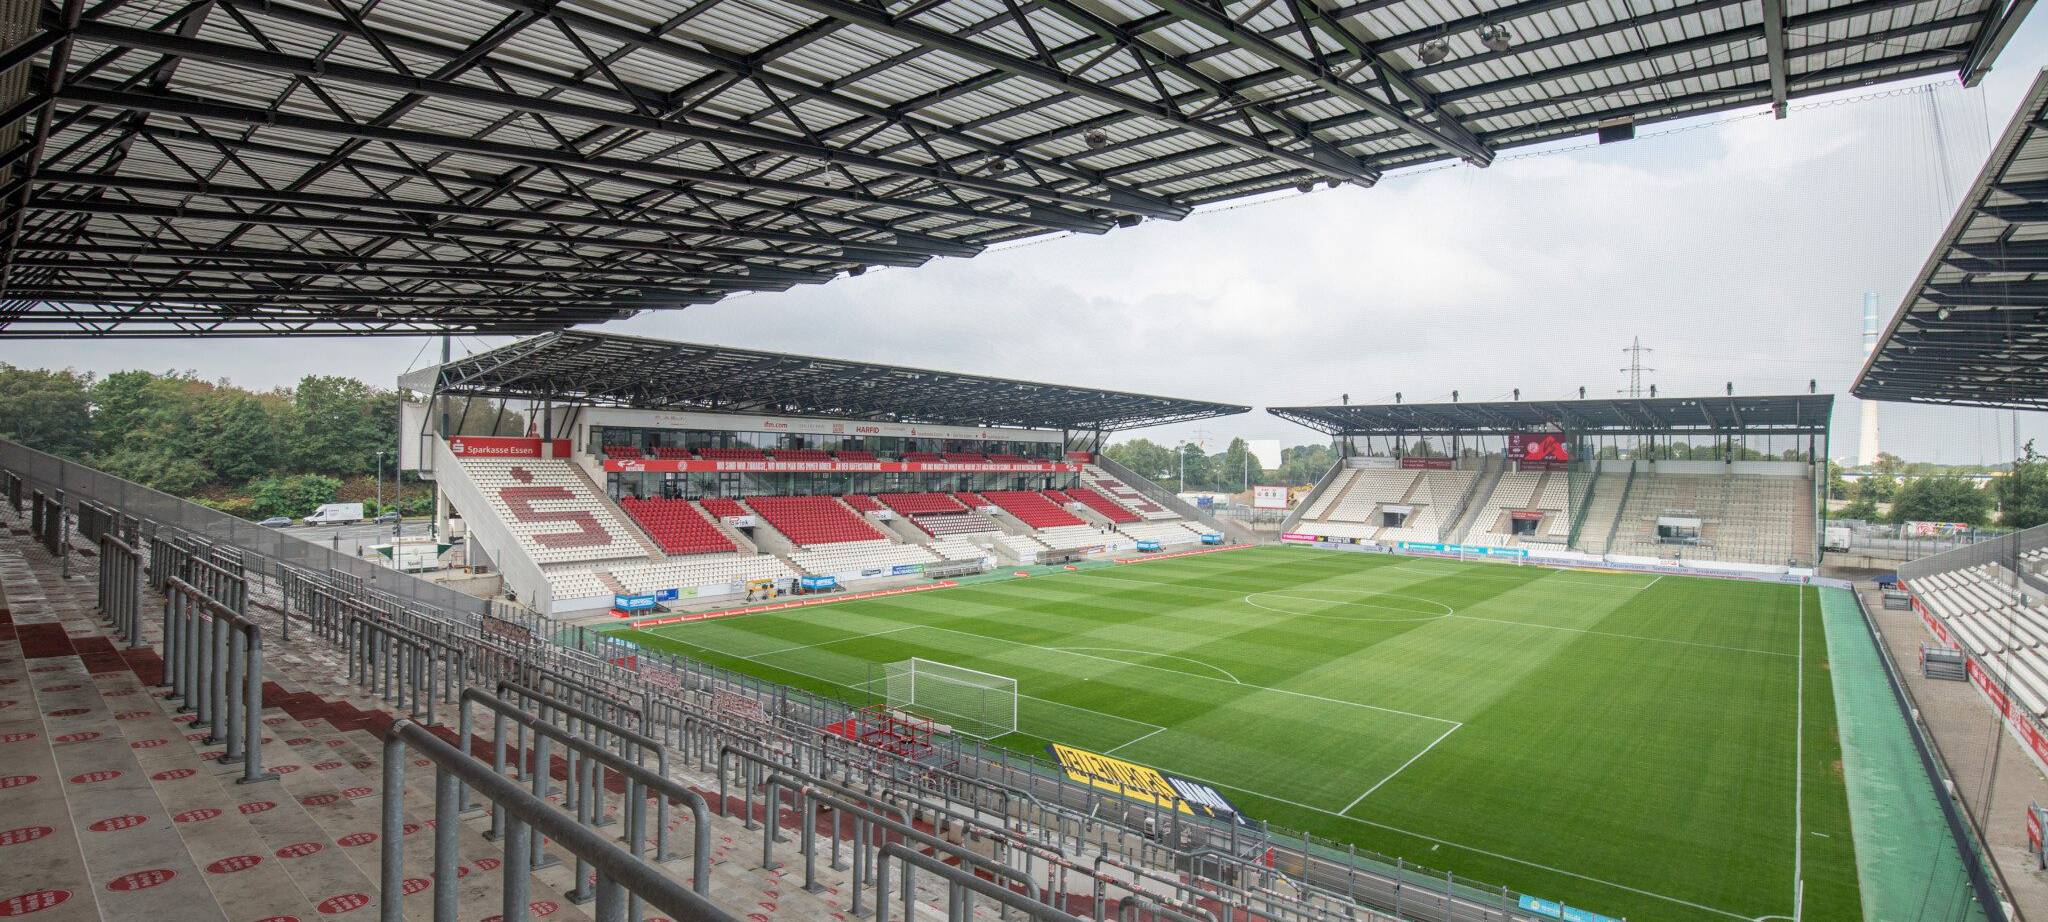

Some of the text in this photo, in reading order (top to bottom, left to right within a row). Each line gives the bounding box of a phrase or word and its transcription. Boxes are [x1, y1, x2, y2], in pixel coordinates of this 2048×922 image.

[467, 445, 534, 456] Sparkasse Essen
[1056, 745, 1173, 801] SPORTWETTEN
